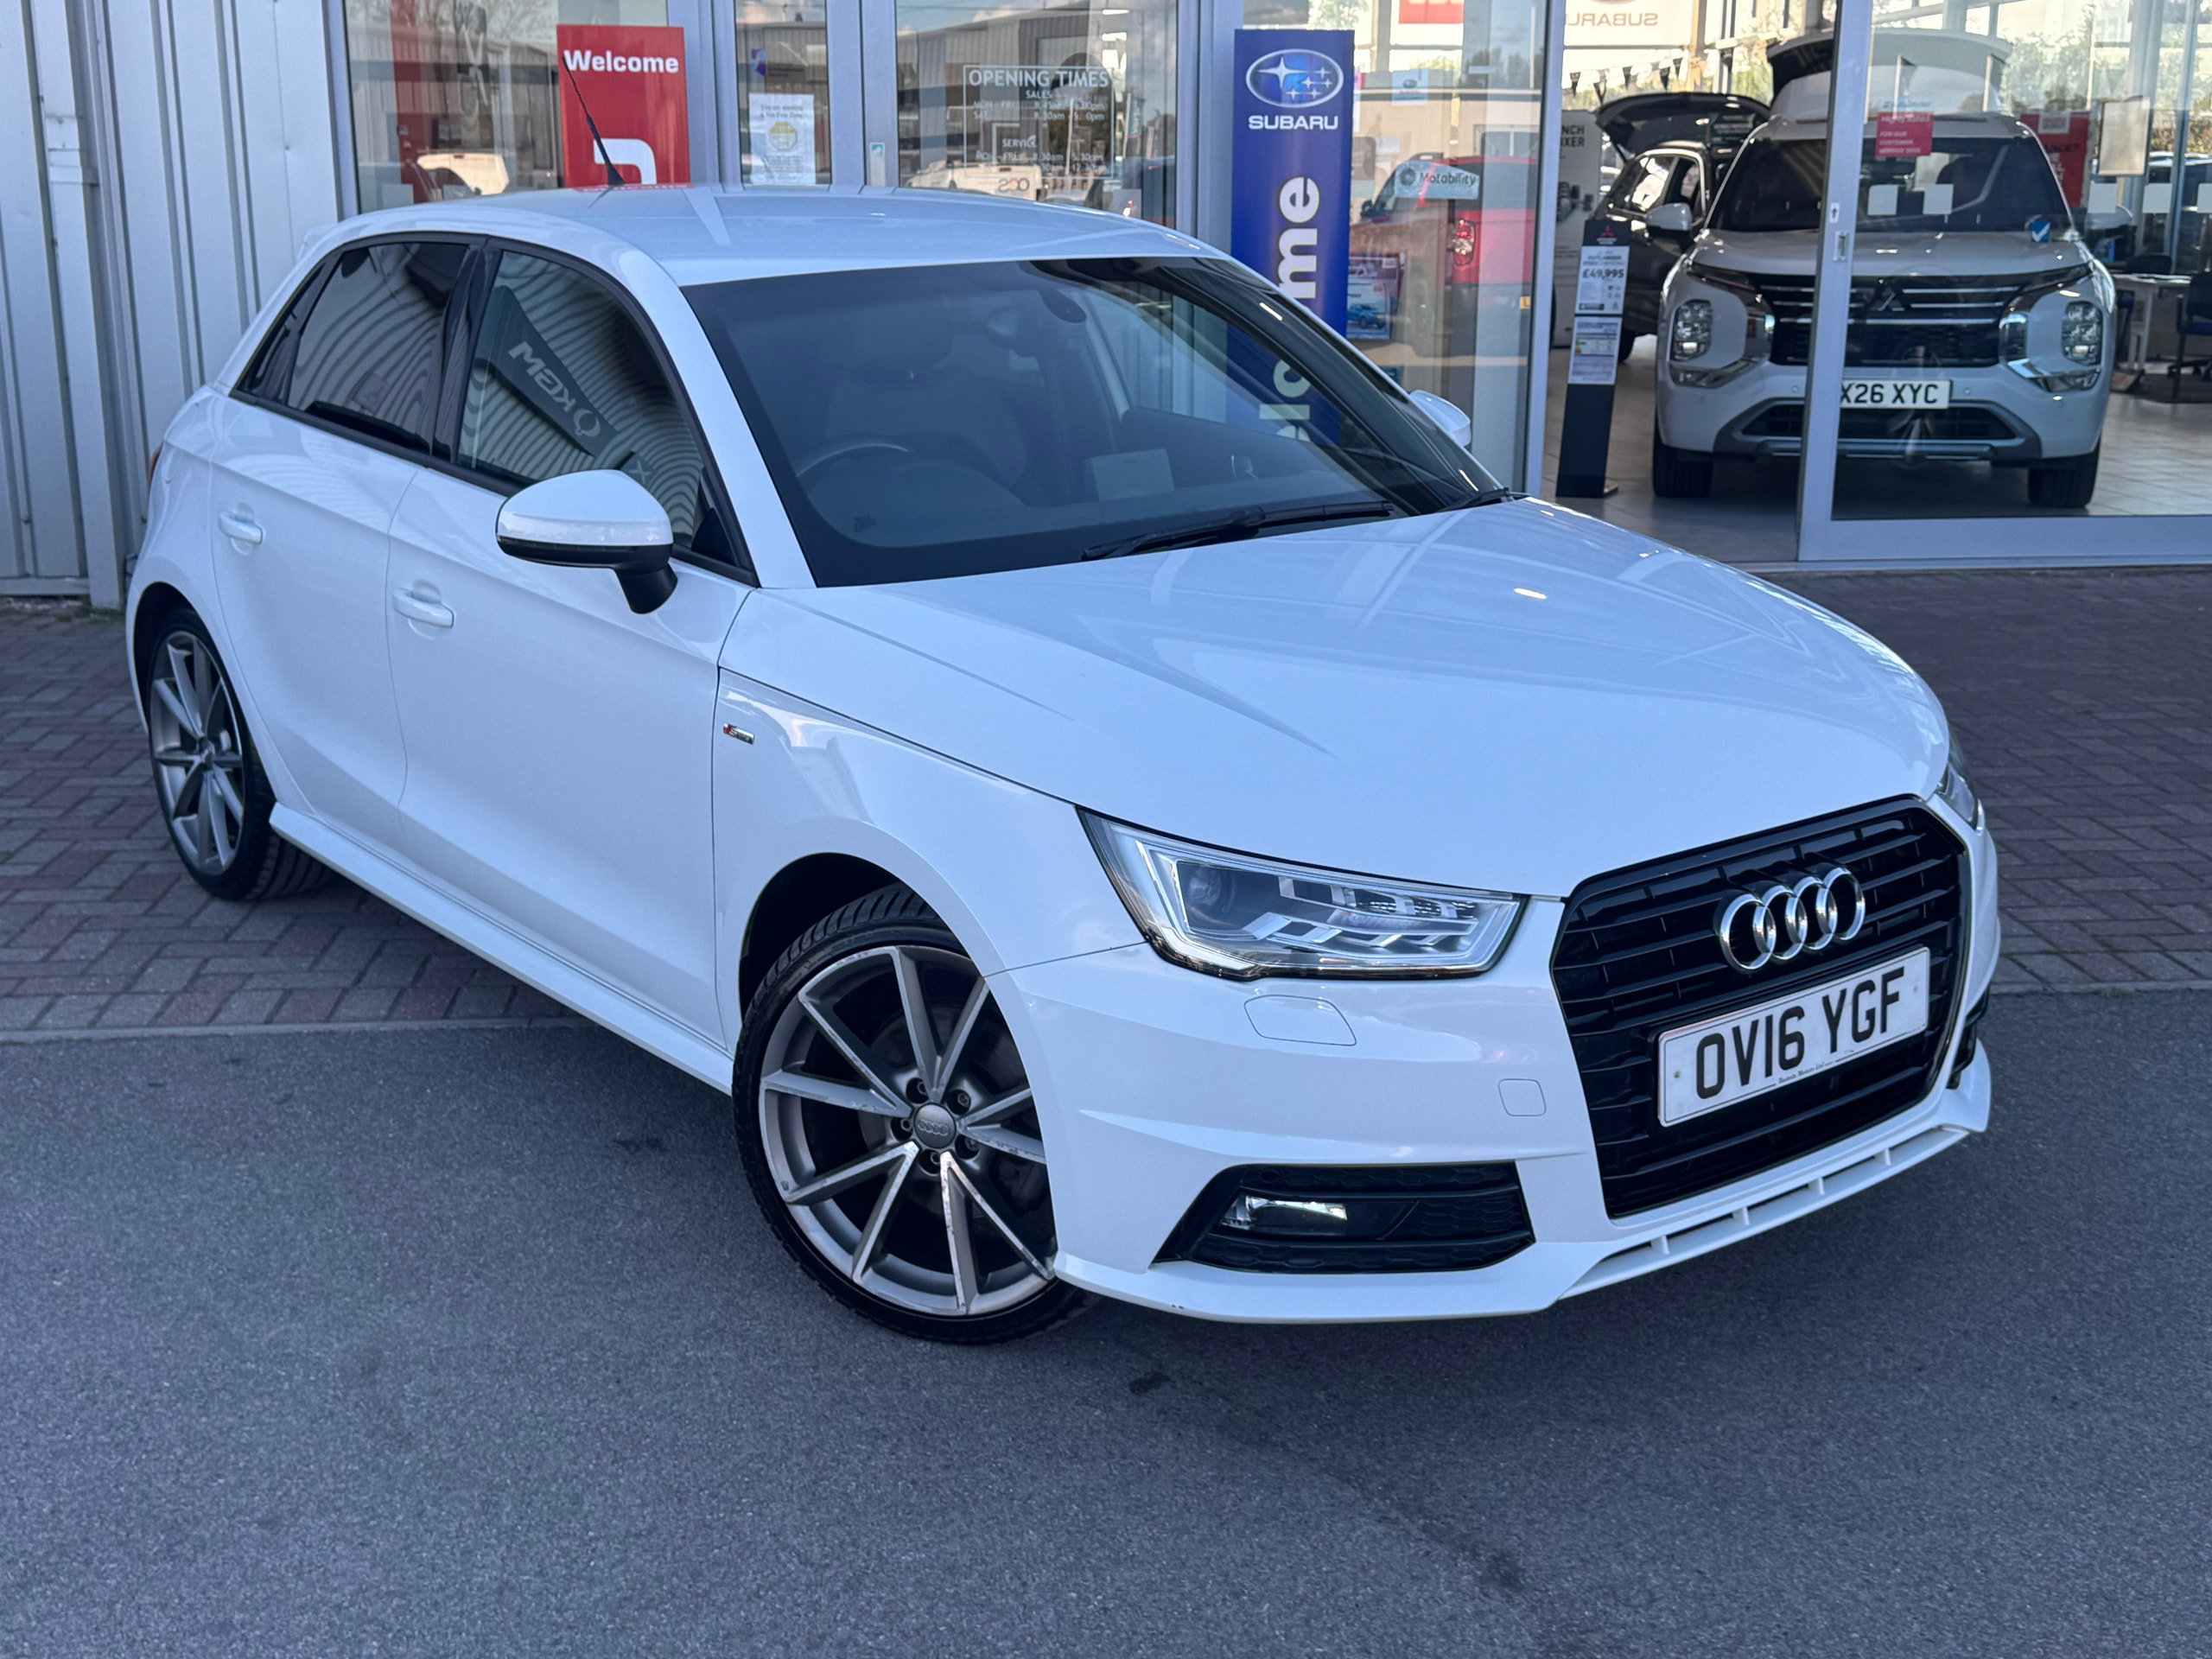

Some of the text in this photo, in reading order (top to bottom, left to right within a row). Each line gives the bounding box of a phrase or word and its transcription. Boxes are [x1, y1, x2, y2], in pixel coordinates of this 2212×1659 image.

[563, 49, 679, 73] Welcome
[969, 69, 1109, 87] OPENING TIMES
[1026, 90, 1052, 99] SALES
[1248, 115, 1338, 130] SUBARU
[1002, 138, 1037, 148] SERVICE
[1560, 137, 1585, 147] XER
[1420, 172, 1476, 188] Motability
[1840, 383, 1939, 404] X26 XYC
[1695, 966, 1905, 1100] OV16 YGF
